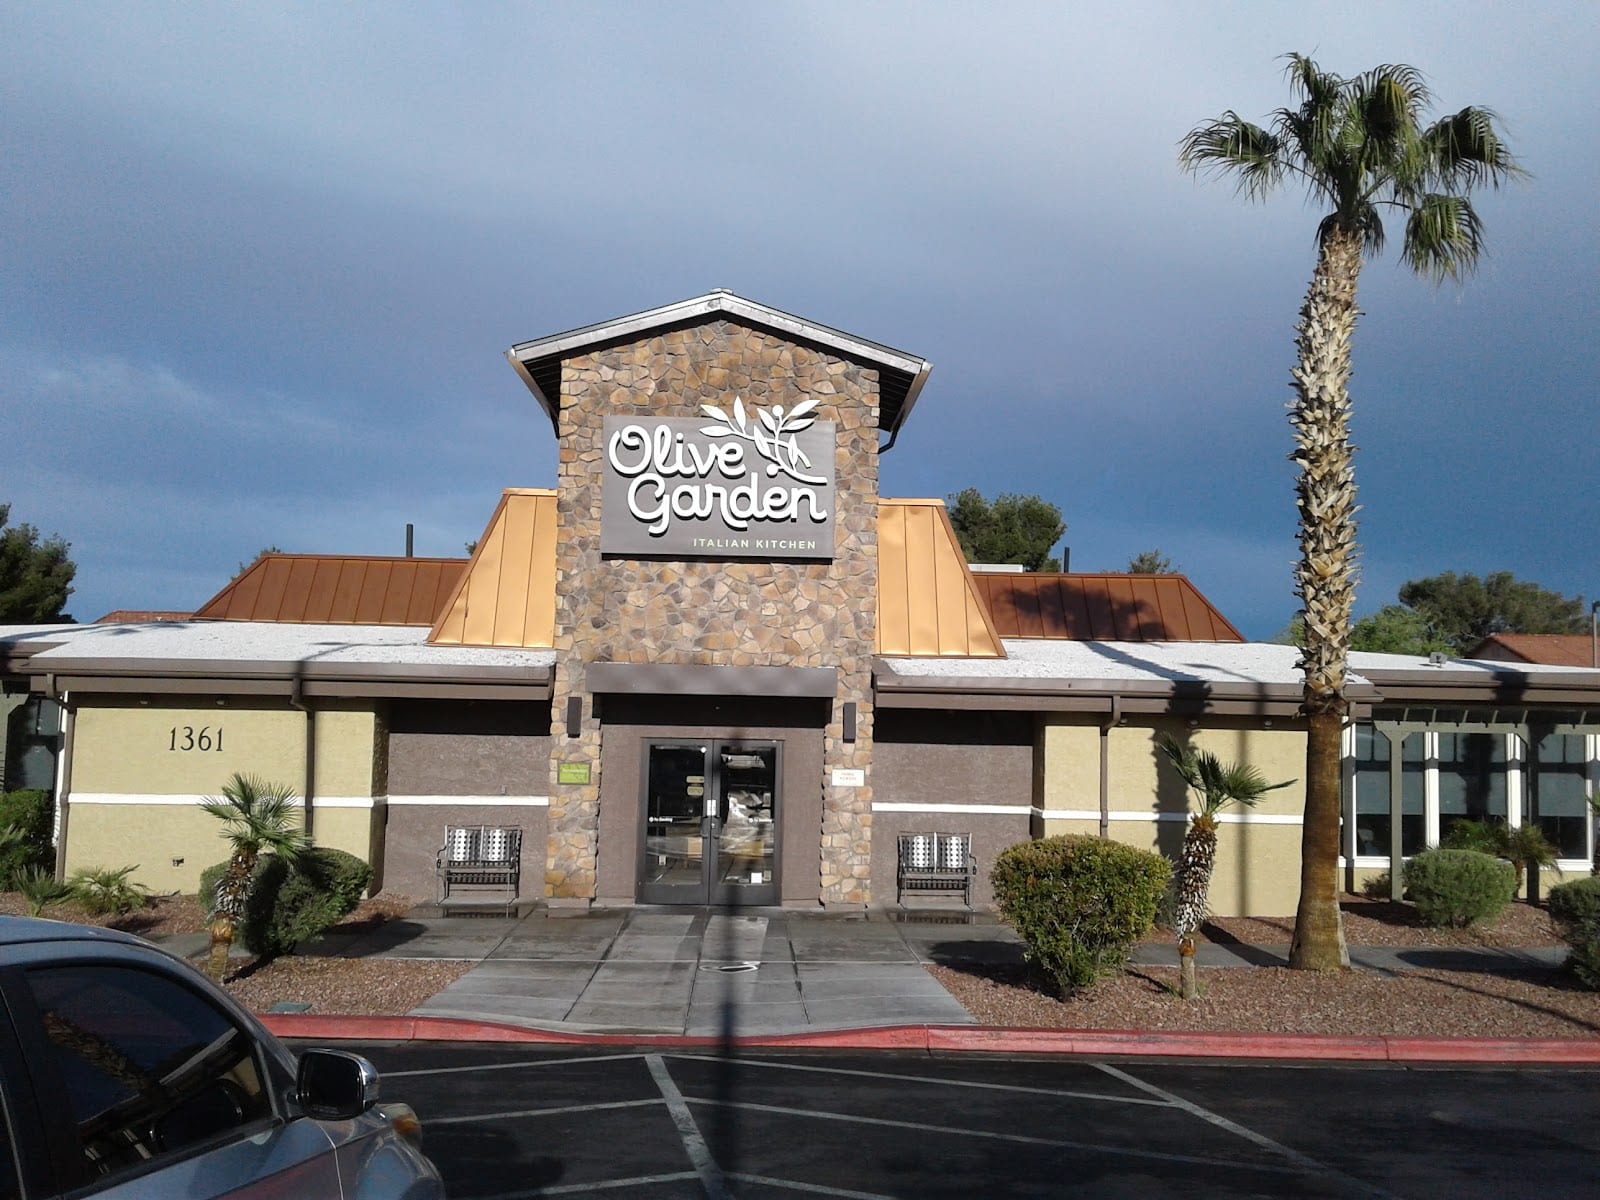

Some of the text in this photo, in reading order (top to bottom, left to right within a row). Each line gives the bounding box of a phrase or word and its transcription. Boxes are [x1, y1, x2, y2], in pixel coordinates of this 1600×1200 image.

[609, 424, 746, 476] Olive
[627, 472, 828, 535] Garden
[693, 538, 816, 549] ITALIAN KITCHEN
[169, 726, 223, 751] 1361
